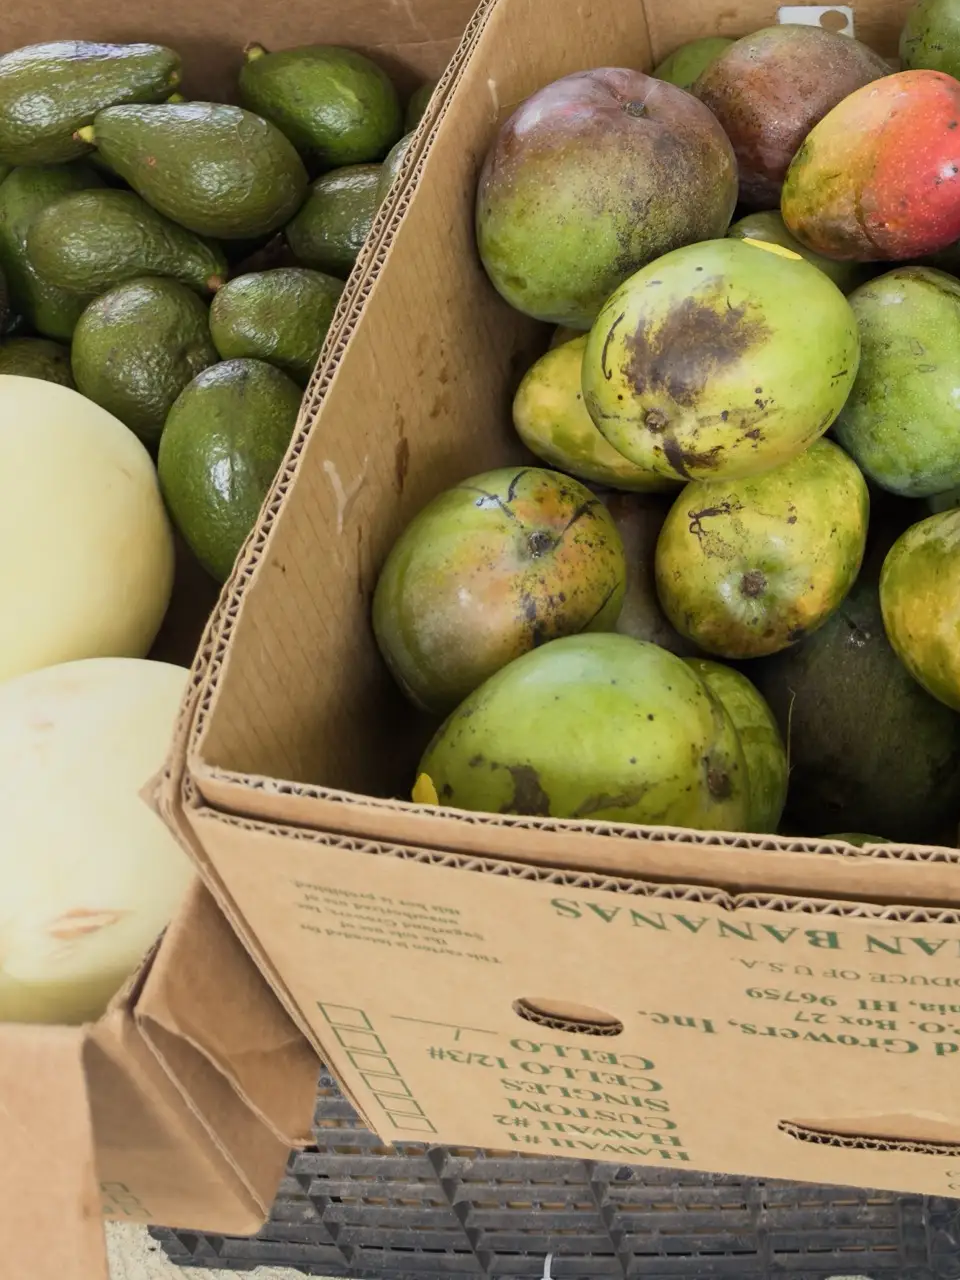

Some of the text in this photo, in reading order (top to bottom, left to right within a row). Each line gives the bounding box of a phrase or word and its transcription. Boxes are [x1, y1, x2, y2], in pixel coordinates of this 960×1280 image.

[547, 897, 844, 952] BANANAS
[821, 967, 862, 981] OF
[744, 986, 839, 1009] 96759
[856, 997, 898, 1014] HI
[636, 1010, 718, 1034] Inc.
[792, 1010, 828, 1026] 27
[837, 1014, 898, 1032] Box
[727, 1018, 920, 1055] Growers,
[508, 1038, 655, 1072] CELLO
[519, 1060, 664, 1093] CELLO
[498, 1078, 671, 1113] SINGLES
[501, 1097, 678, 1130] CUSTOM
[491, 1113, 684, 1148] HAWAII #2
[505, 1131, 691, 1162] HAWAII #1
